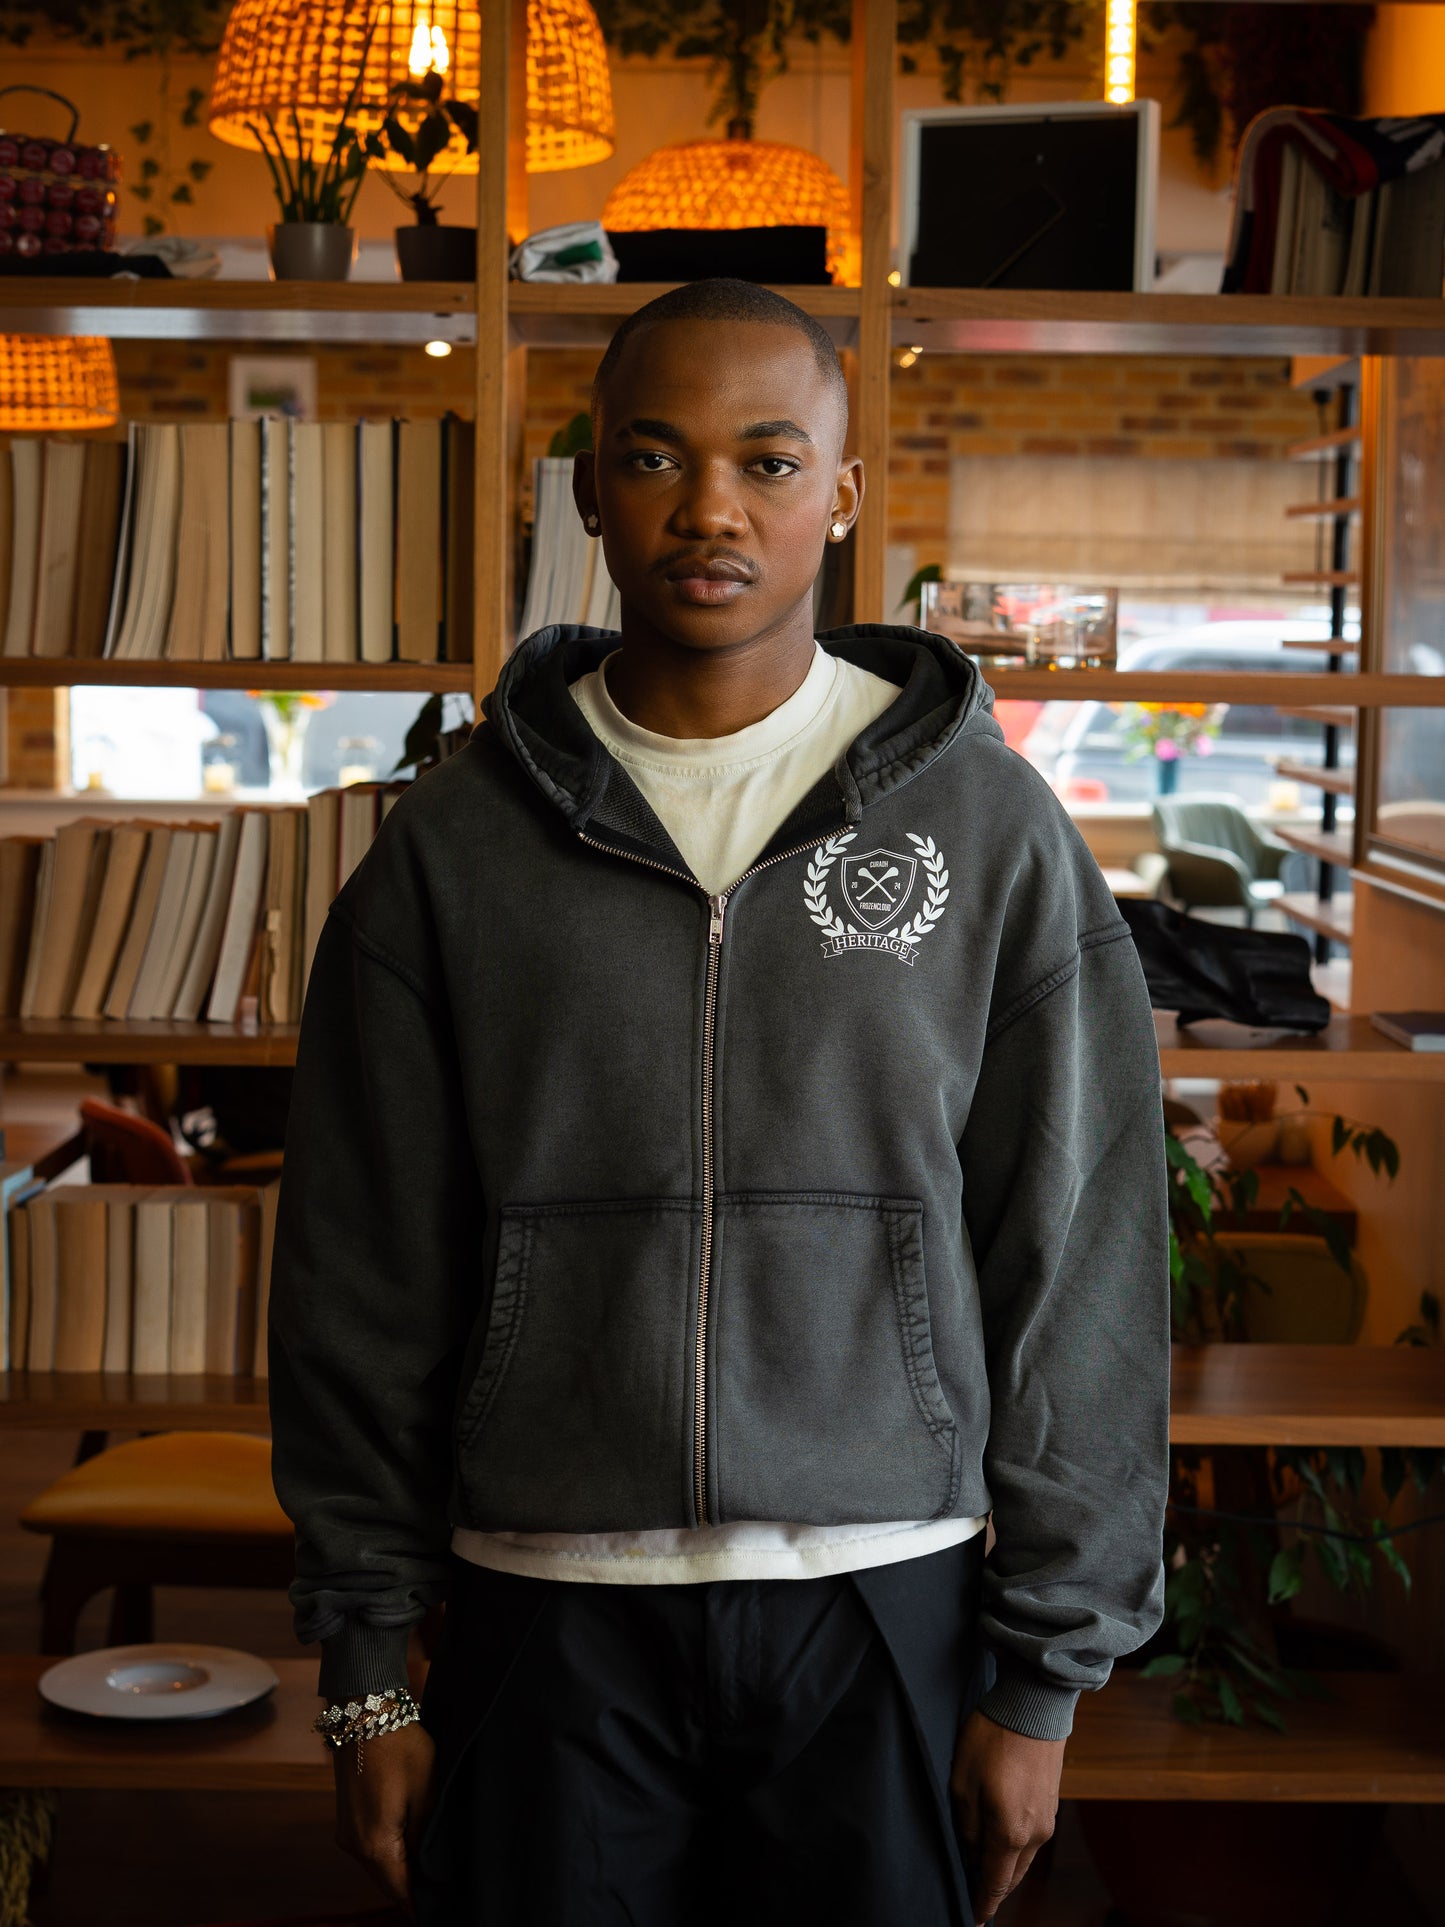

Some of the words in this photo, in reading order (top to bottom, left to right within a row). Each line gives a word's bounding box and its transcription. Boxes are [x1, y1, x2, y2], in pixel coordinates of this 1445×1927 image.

[851, 881, 858, 889] 20
[894, 882, 901, 890] 24
[859, 902, 892, 912] FROZENCLOUD
[834, 934, 910, 956] HERITAGE
